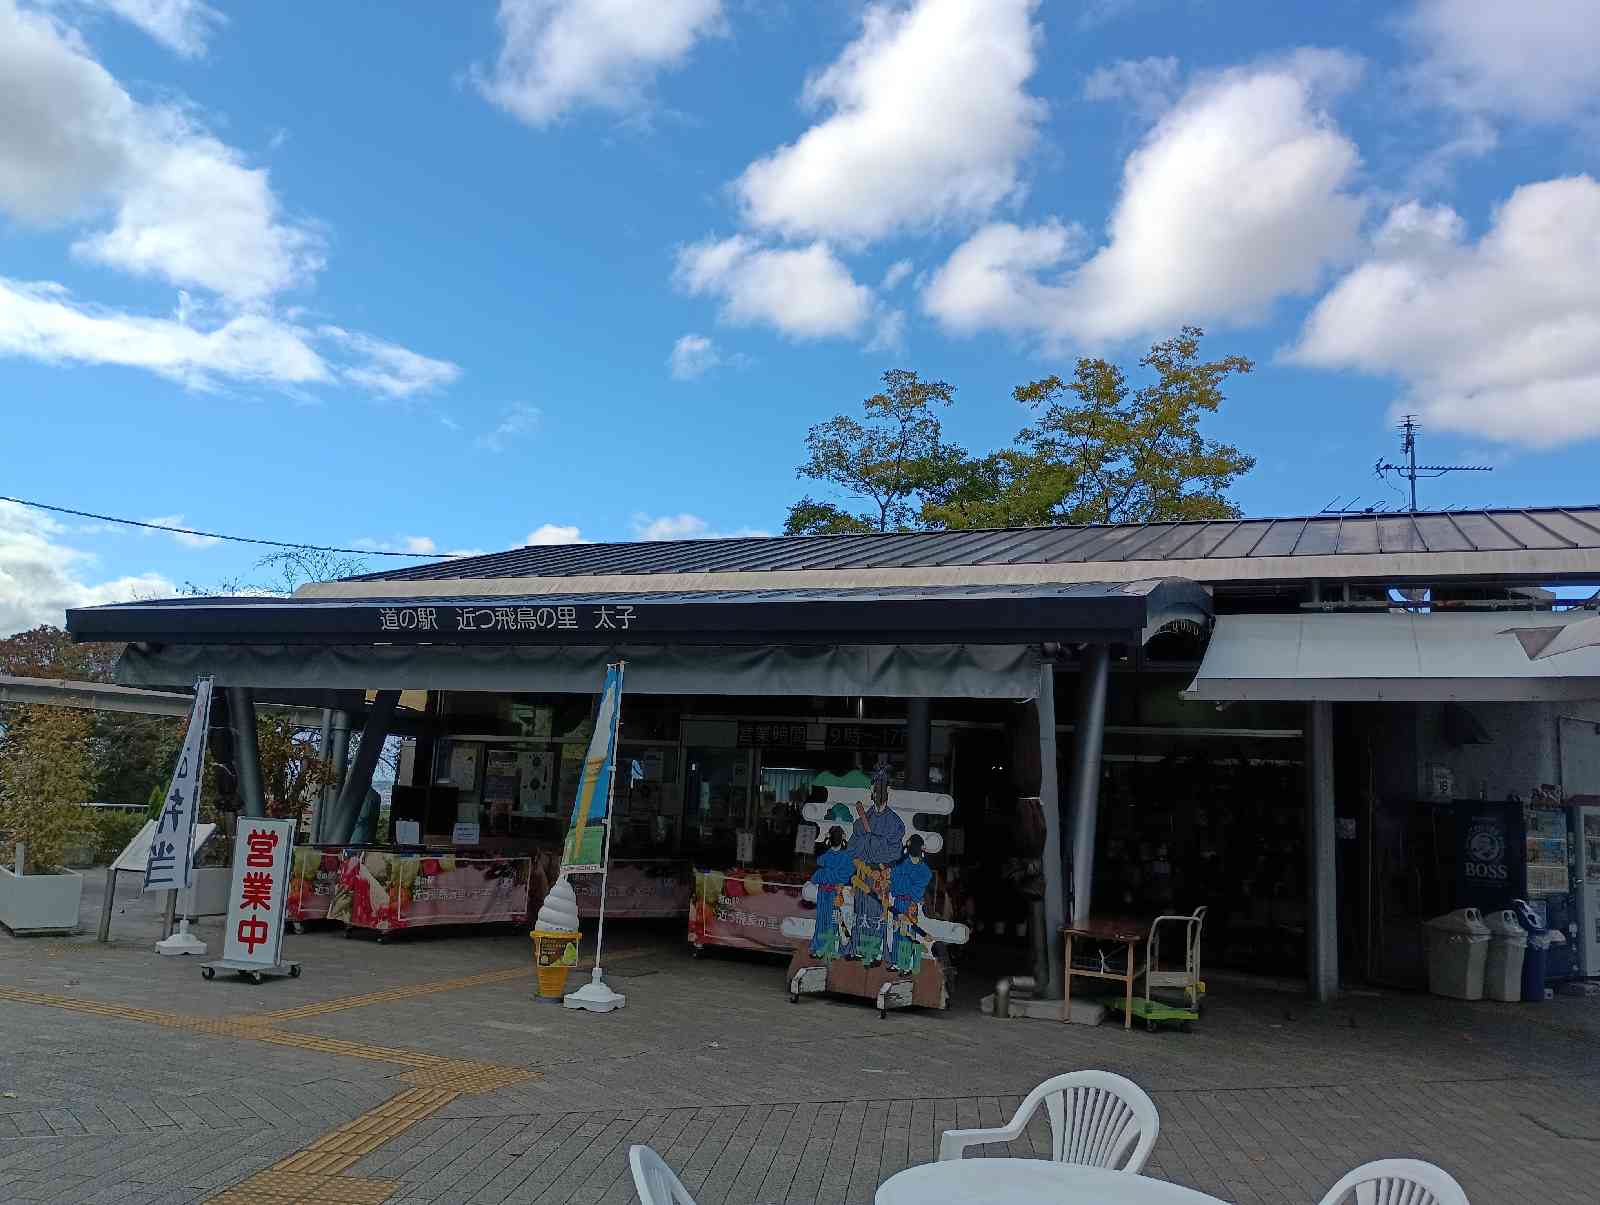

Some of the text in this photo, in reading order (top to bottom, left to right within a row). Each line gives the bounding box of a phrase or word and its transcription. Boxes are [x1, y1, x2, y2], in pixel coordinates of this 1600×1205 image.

[379, 604, 637, 631] 道の駅 近つ飛鳥の里 太子
[1464, 862, 1508, 880] BOSS
[237, 829, 278, 954] 営業中
